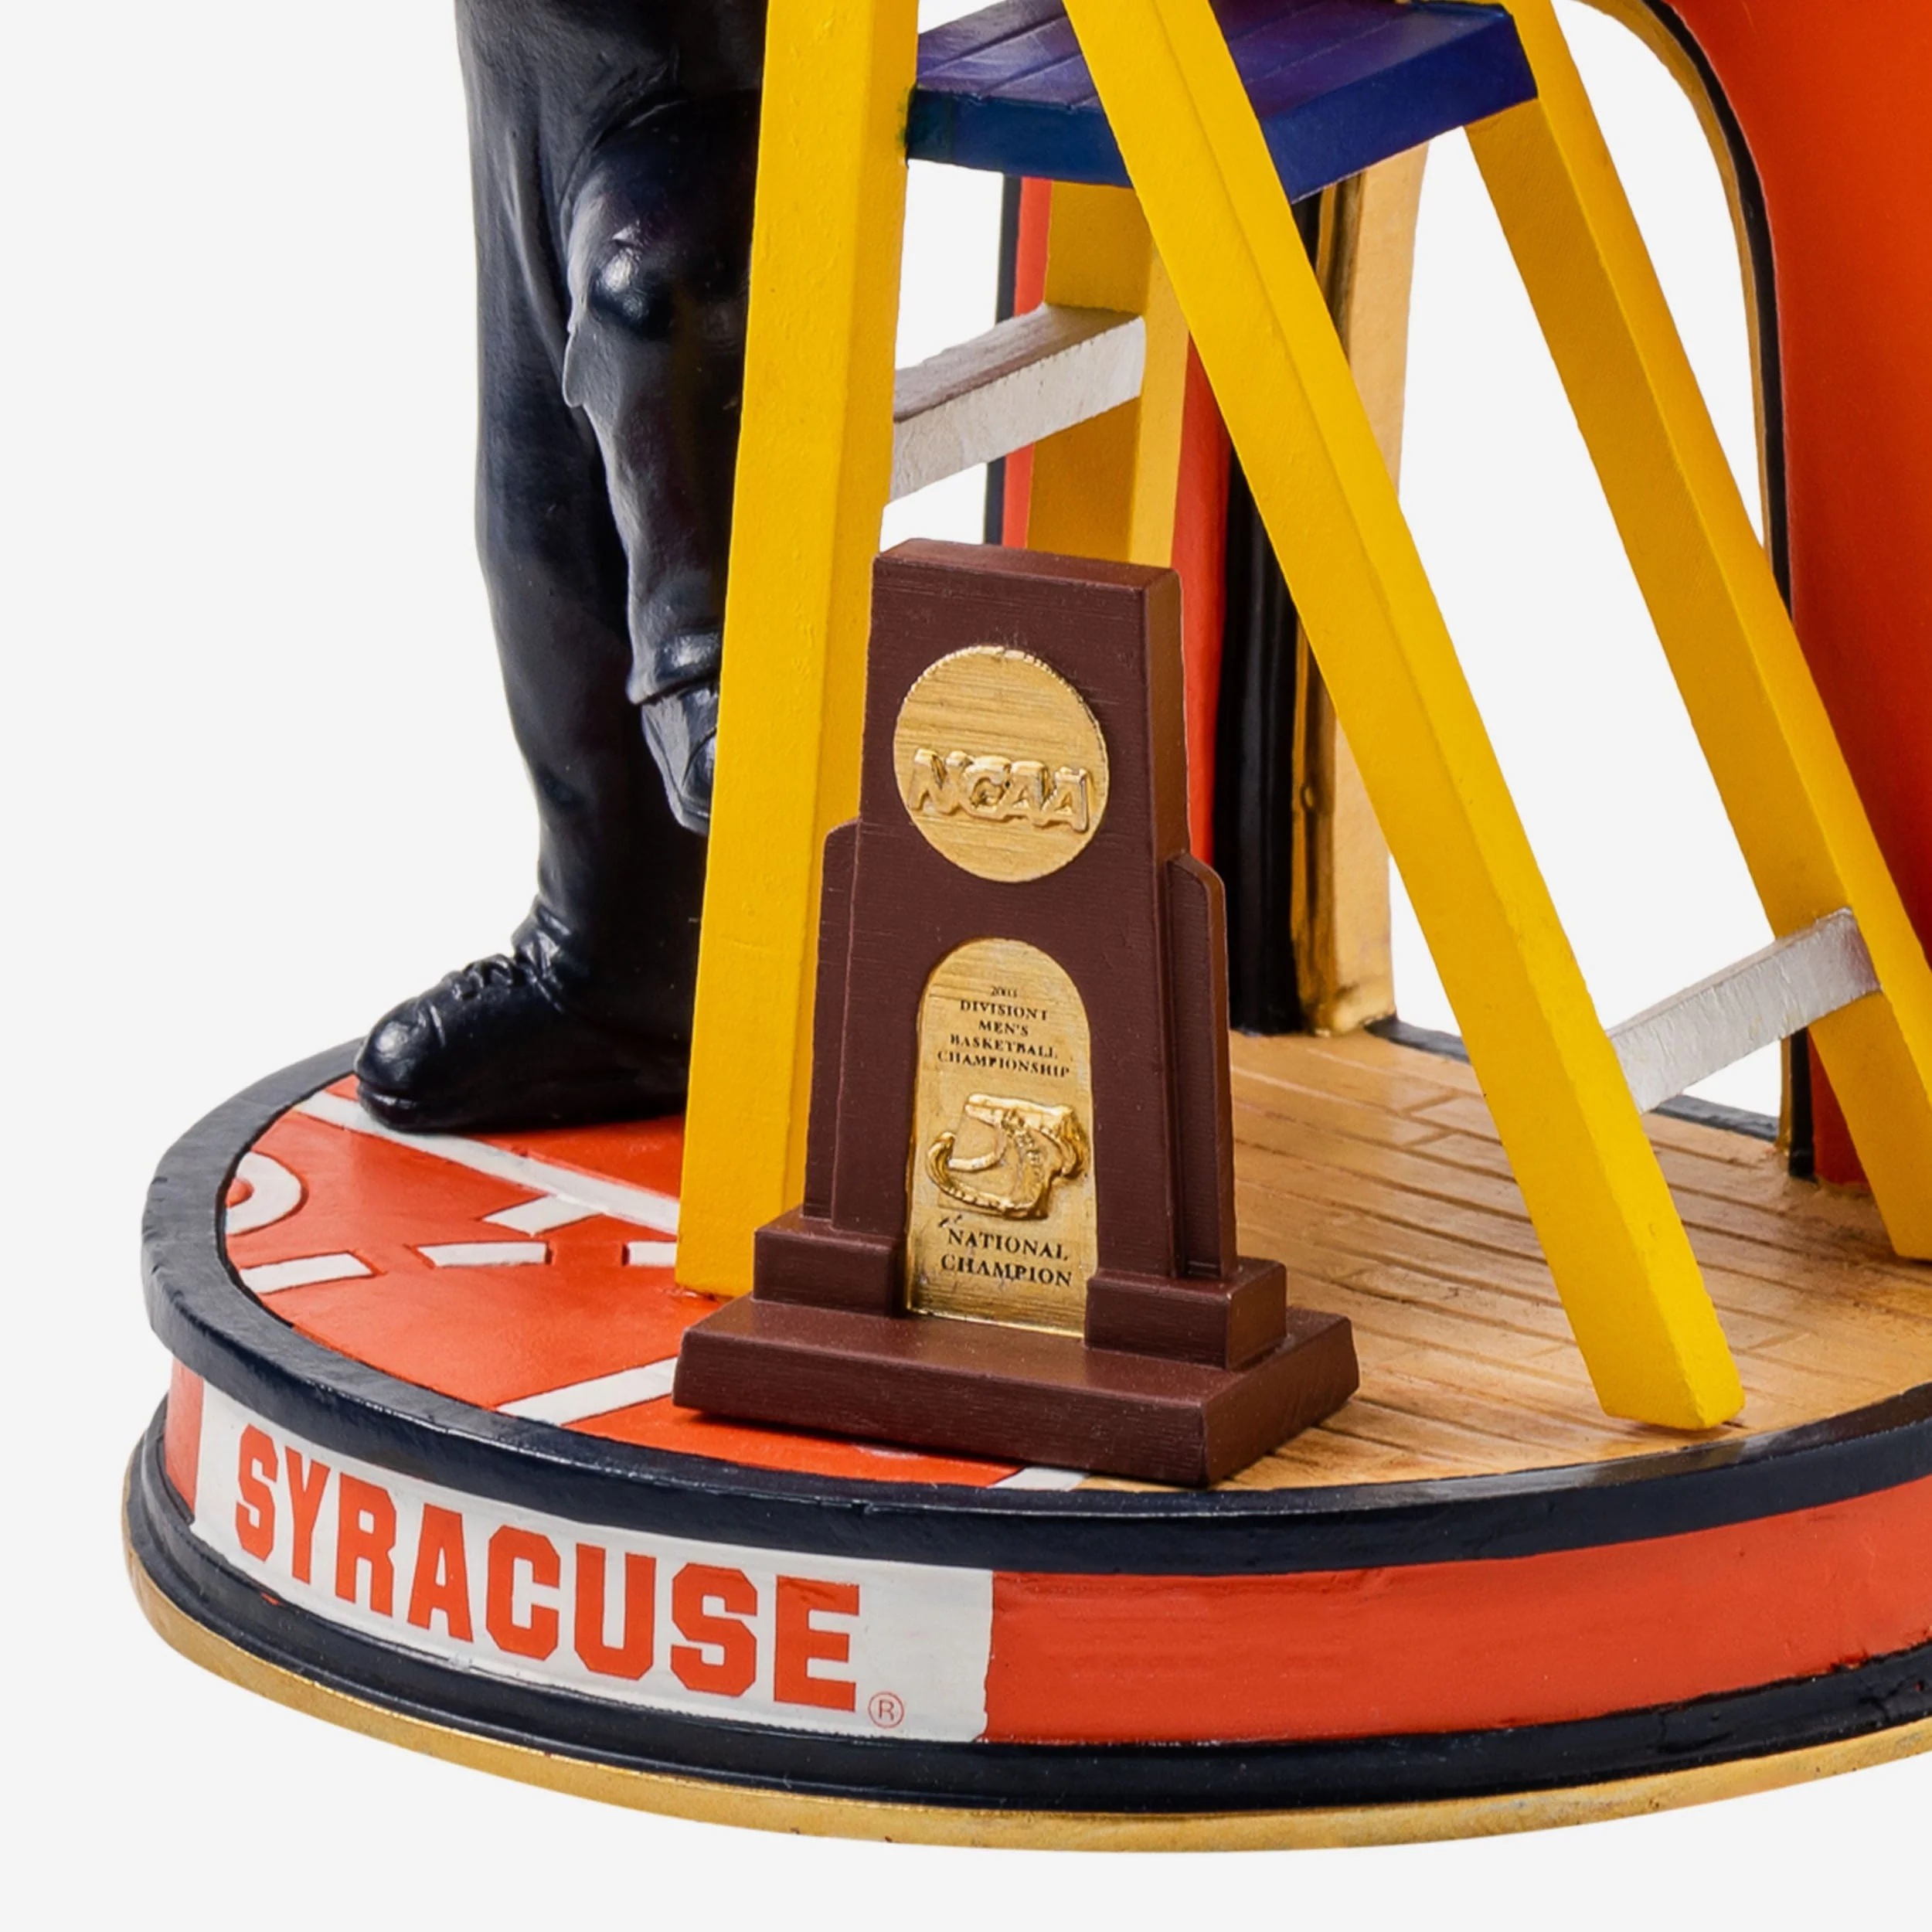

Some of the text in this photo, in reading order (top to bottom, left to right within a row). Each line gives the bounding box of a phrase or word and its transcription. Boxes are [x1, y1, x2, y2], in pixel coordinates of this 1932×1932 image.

[910, 749, 1090, 832] NCAA
[961, 1000, 1037, 1019] DIVISION
[979, 1020, 1029, 1036] MEN'S
[951, 1035, 1058, 1059] BASKETBALL
[937, 1051, 1070, 1077] CHAMPIONSHIP
[948, 1229, 1068, 1260] NATIONAL
[941, 1255, 1072, 1287] CHAMPION
[235, 1423, 860, 1713] SYRACUSE
